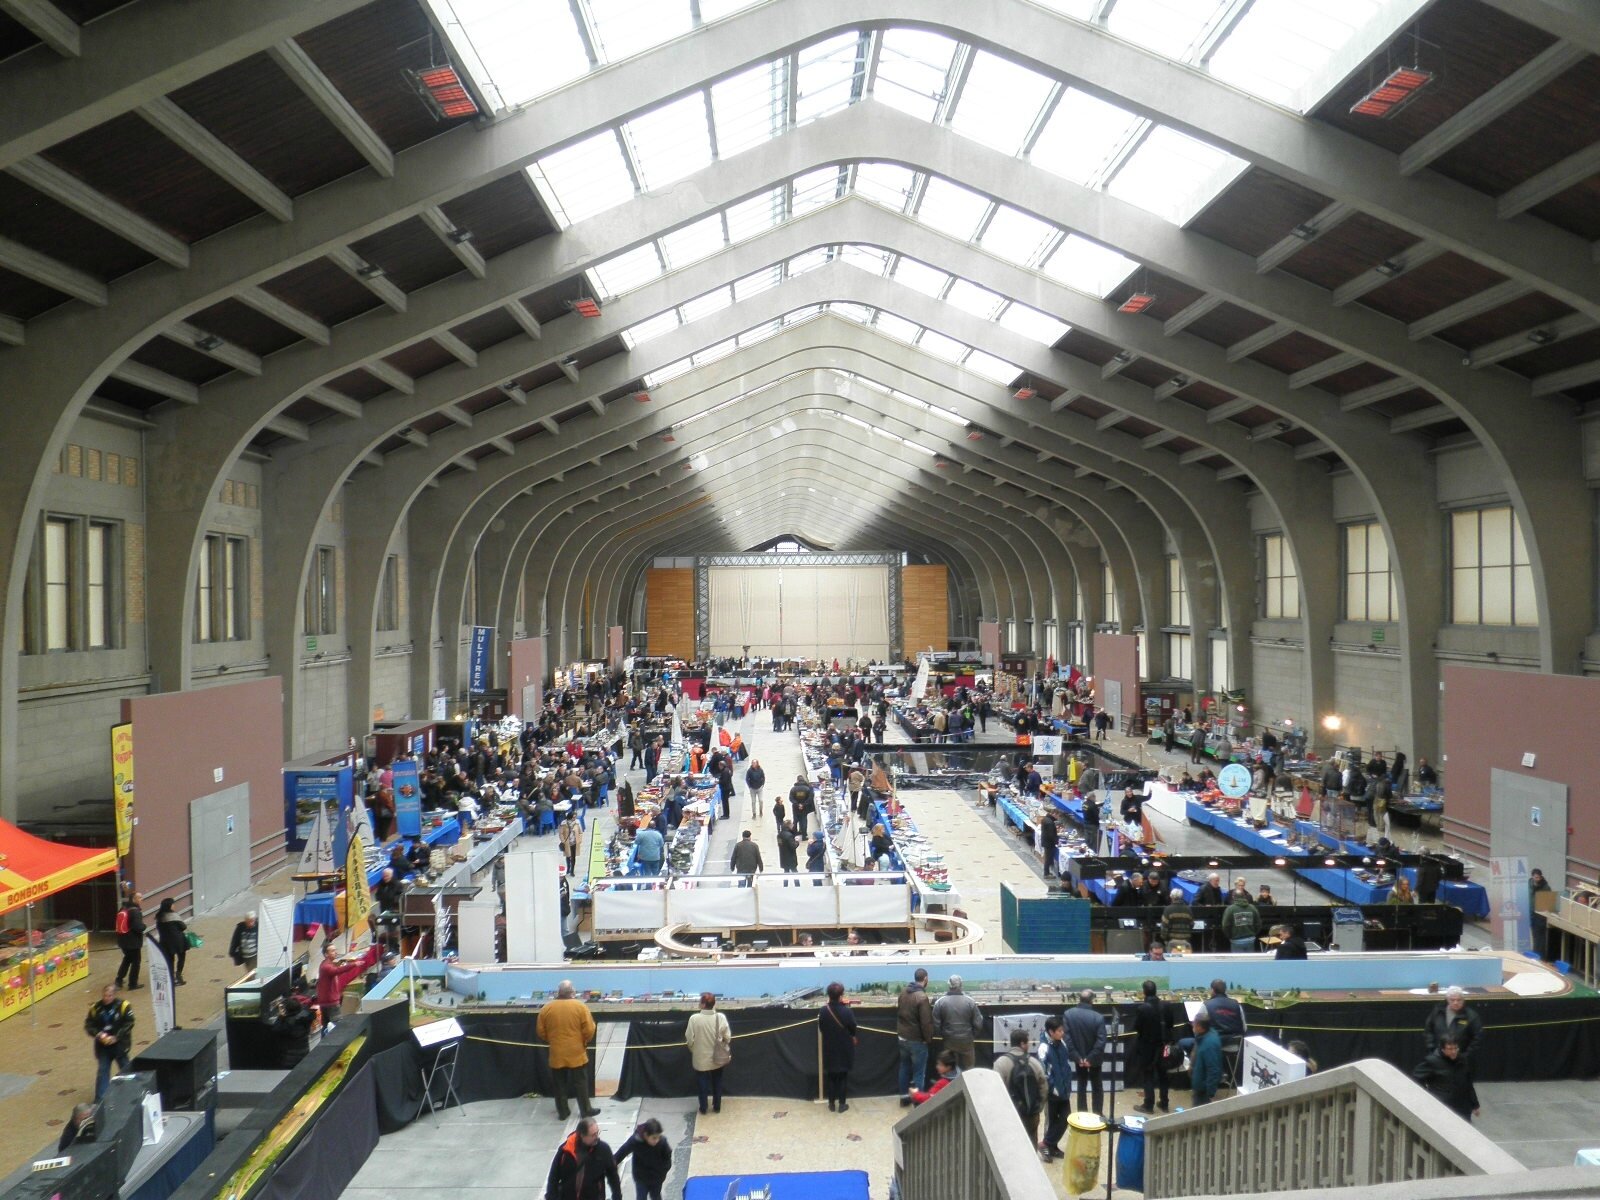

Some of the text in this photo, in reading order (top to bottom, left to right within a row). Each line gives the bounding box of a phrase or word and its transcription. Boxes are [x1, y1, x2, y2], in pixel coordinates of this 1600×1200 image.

[473, 628, 486, 687] MULTIREX
[2, 993, 14, 1009] les
[18, 980, 43, 1004] petts
[45, 974, 54, 985] et
[56, 966, 68, 980] les
